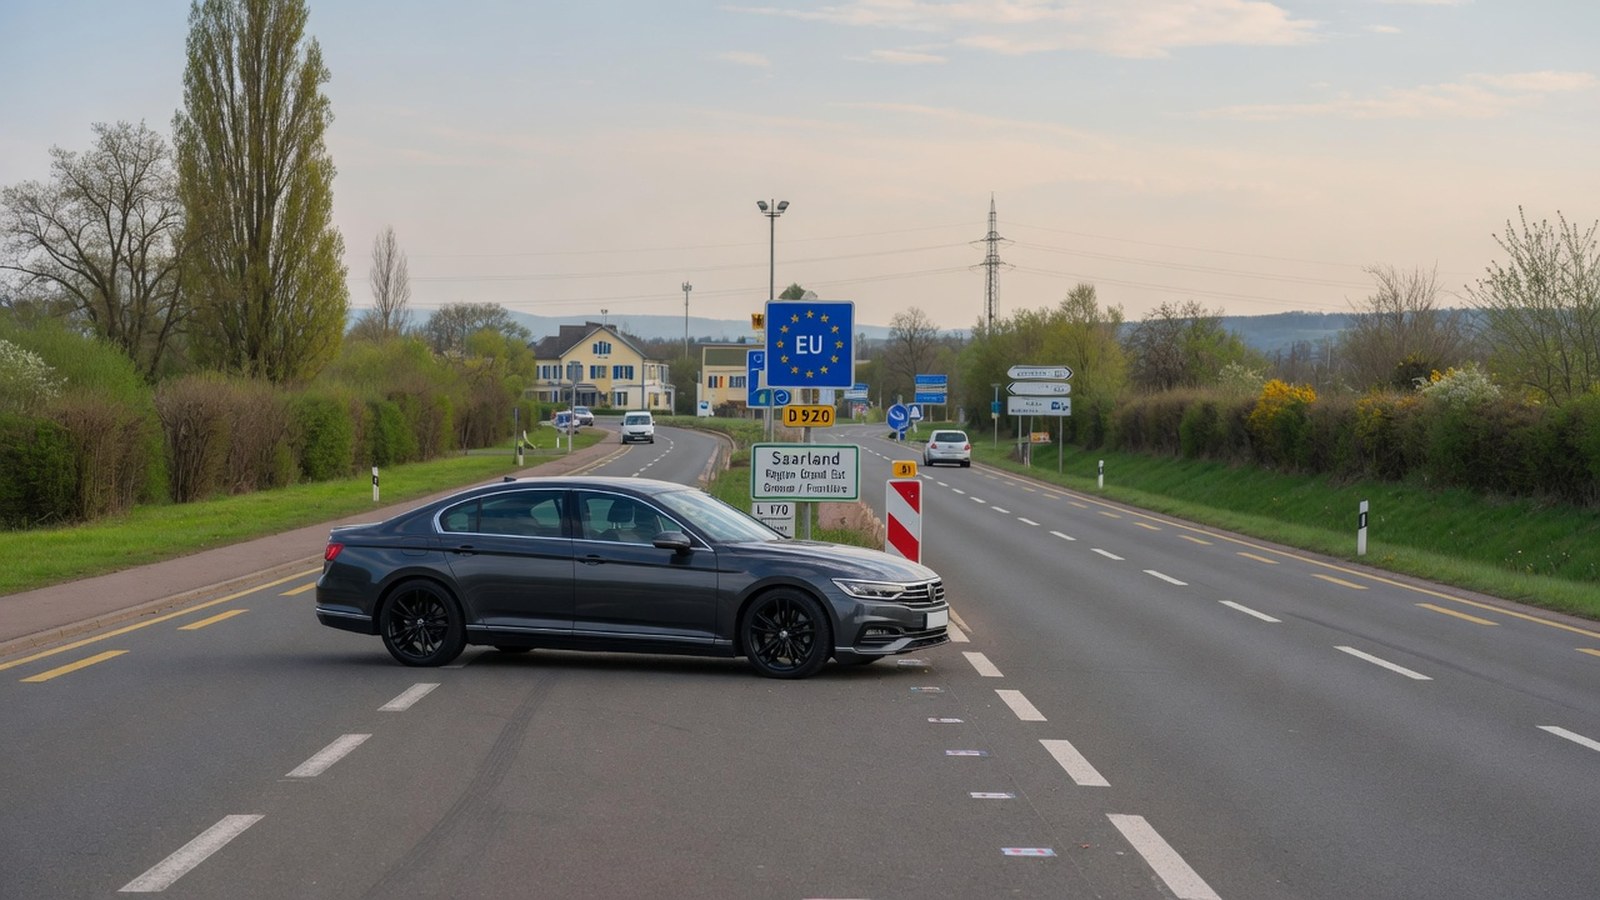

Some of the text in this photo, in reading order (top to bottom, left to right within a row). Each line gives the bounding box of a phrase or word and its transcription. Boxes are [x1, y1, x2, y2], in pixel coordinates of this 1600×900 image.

[796, 335, 822, 354] EU
[789, 409, 797, 422] D
[772, 451, 840, 466] Saarland
[756, 505, 763, 515] L
